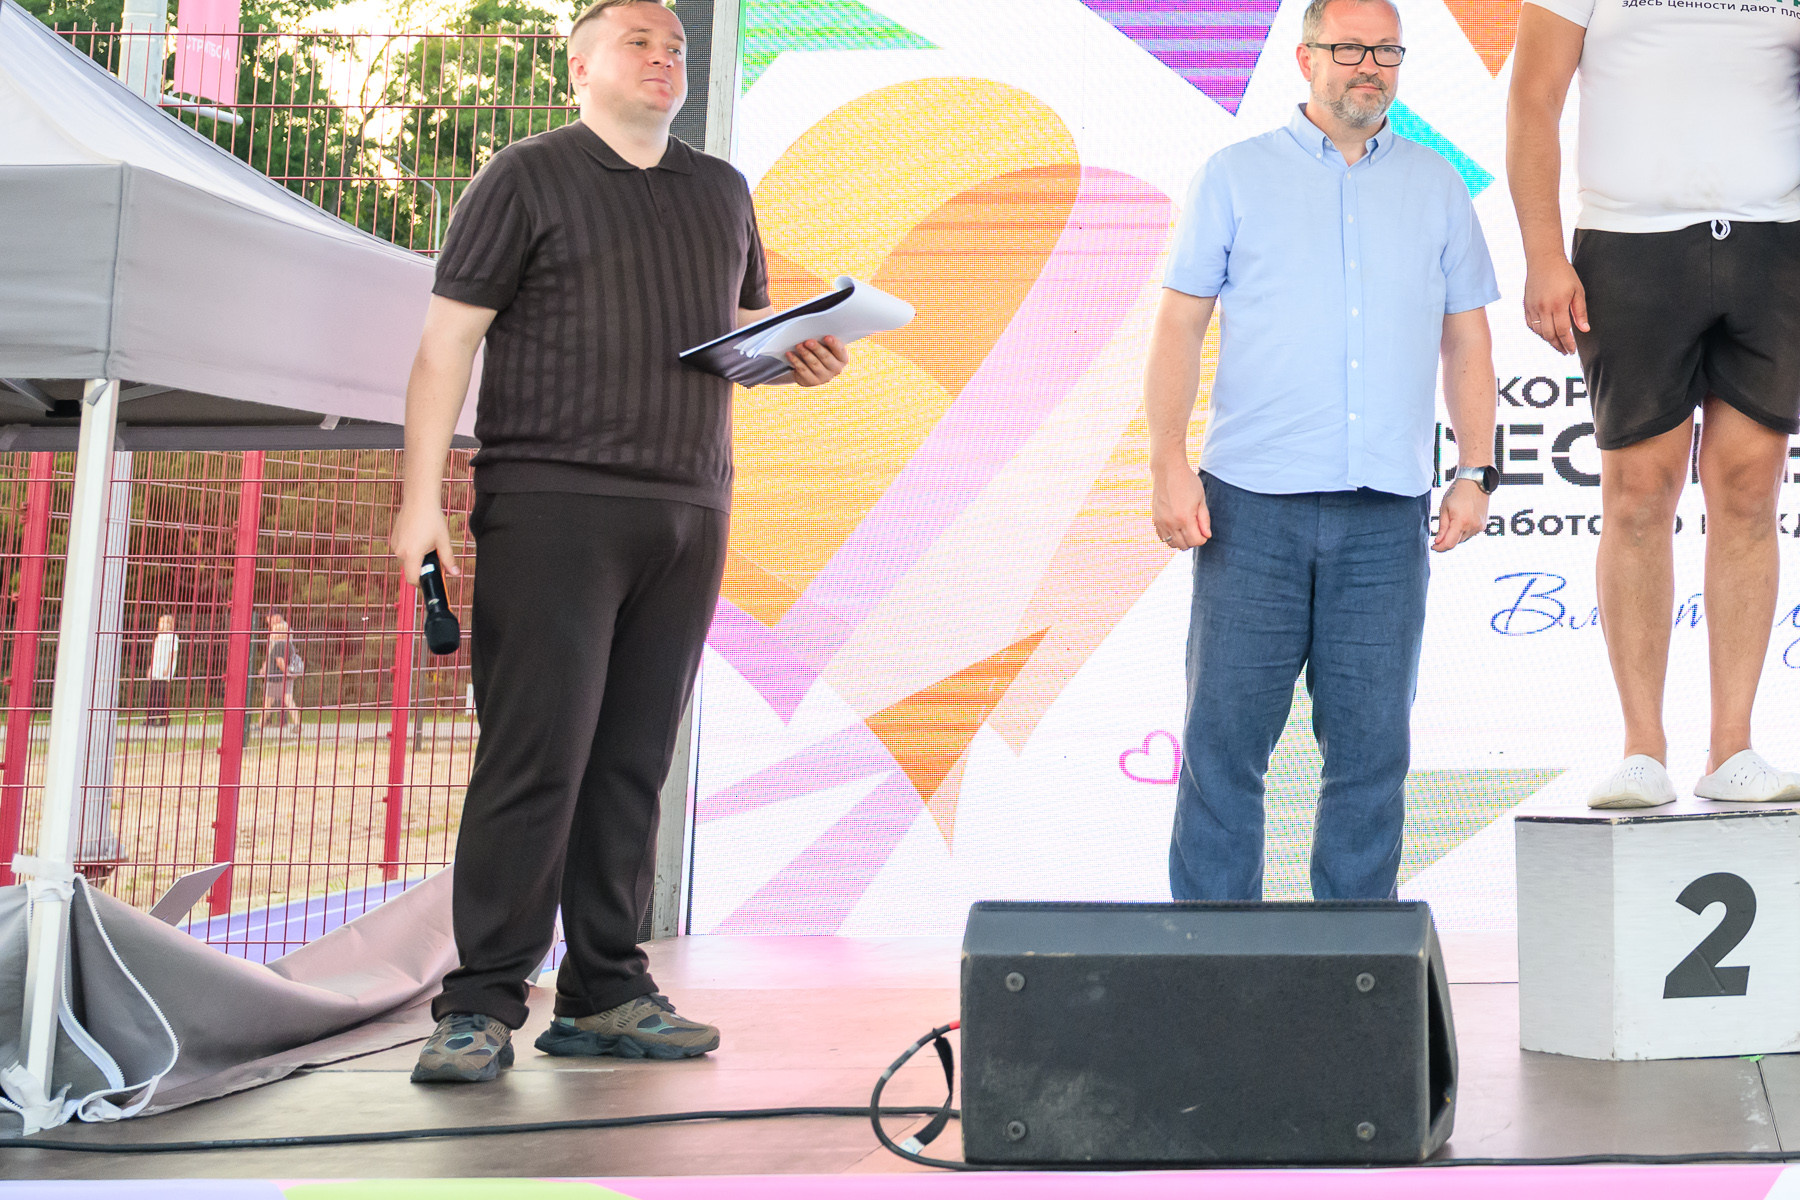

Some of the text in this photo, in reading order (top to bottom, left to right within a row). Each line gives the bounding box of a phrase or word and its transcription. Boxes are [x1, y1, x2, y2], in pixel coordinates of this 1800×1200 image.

[1667, 0, 1736, 10] ценности
[1740, 3, 1777, 15] дают
[1663, 872, 1757, 999] 2
